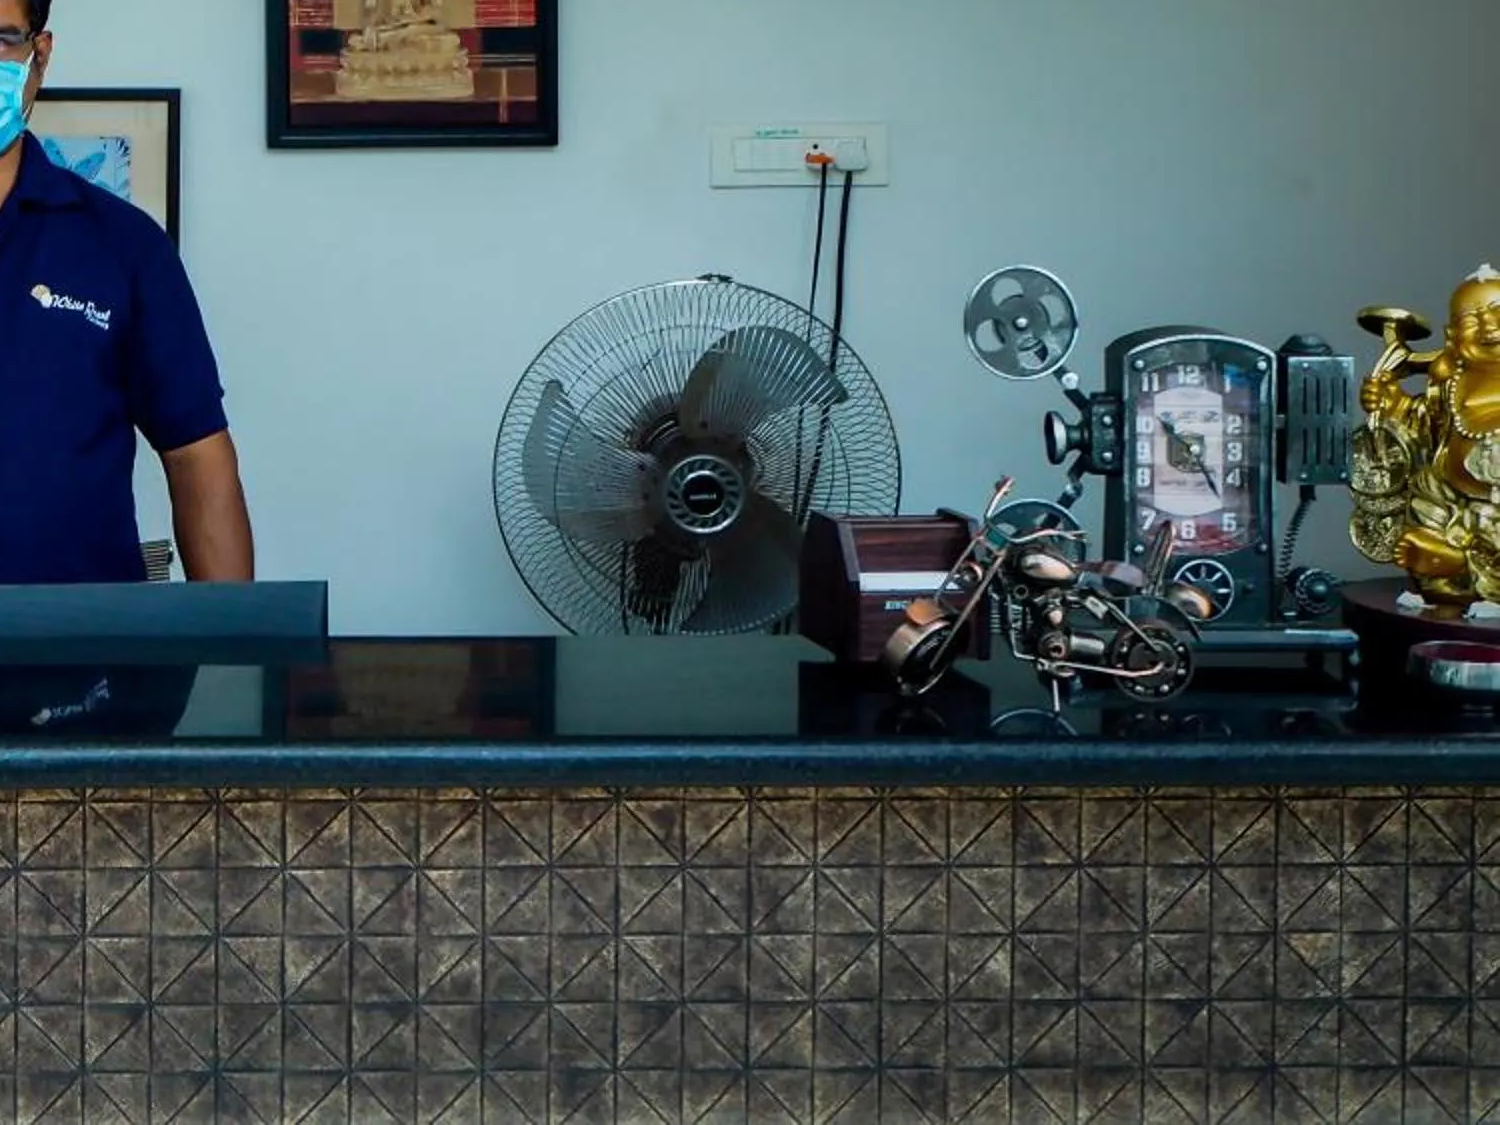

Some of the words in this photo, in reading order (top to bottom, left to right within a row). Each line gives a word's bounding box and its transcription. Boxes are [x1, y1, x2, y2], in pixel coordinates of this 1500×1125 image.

[1141, 372, 1160, 393] 11
[1177, 364, 1200, 386] 12
[1223, 367, 1232, 393] 1
[1135, 415, 1154, 434] 10
[1226, 414, 1242, 434] 2
[1136, 441, 1151, 463] 9
[1227, 442, 1242, 462] 3
[1136, 467, 1151, 488] 8
[1226, 467, 1241, 488] 4
[1141, 508, 1156, 531] 7
[1180, 520, 1196, 539] 6
[1222, 512, 1237, 532] 5
